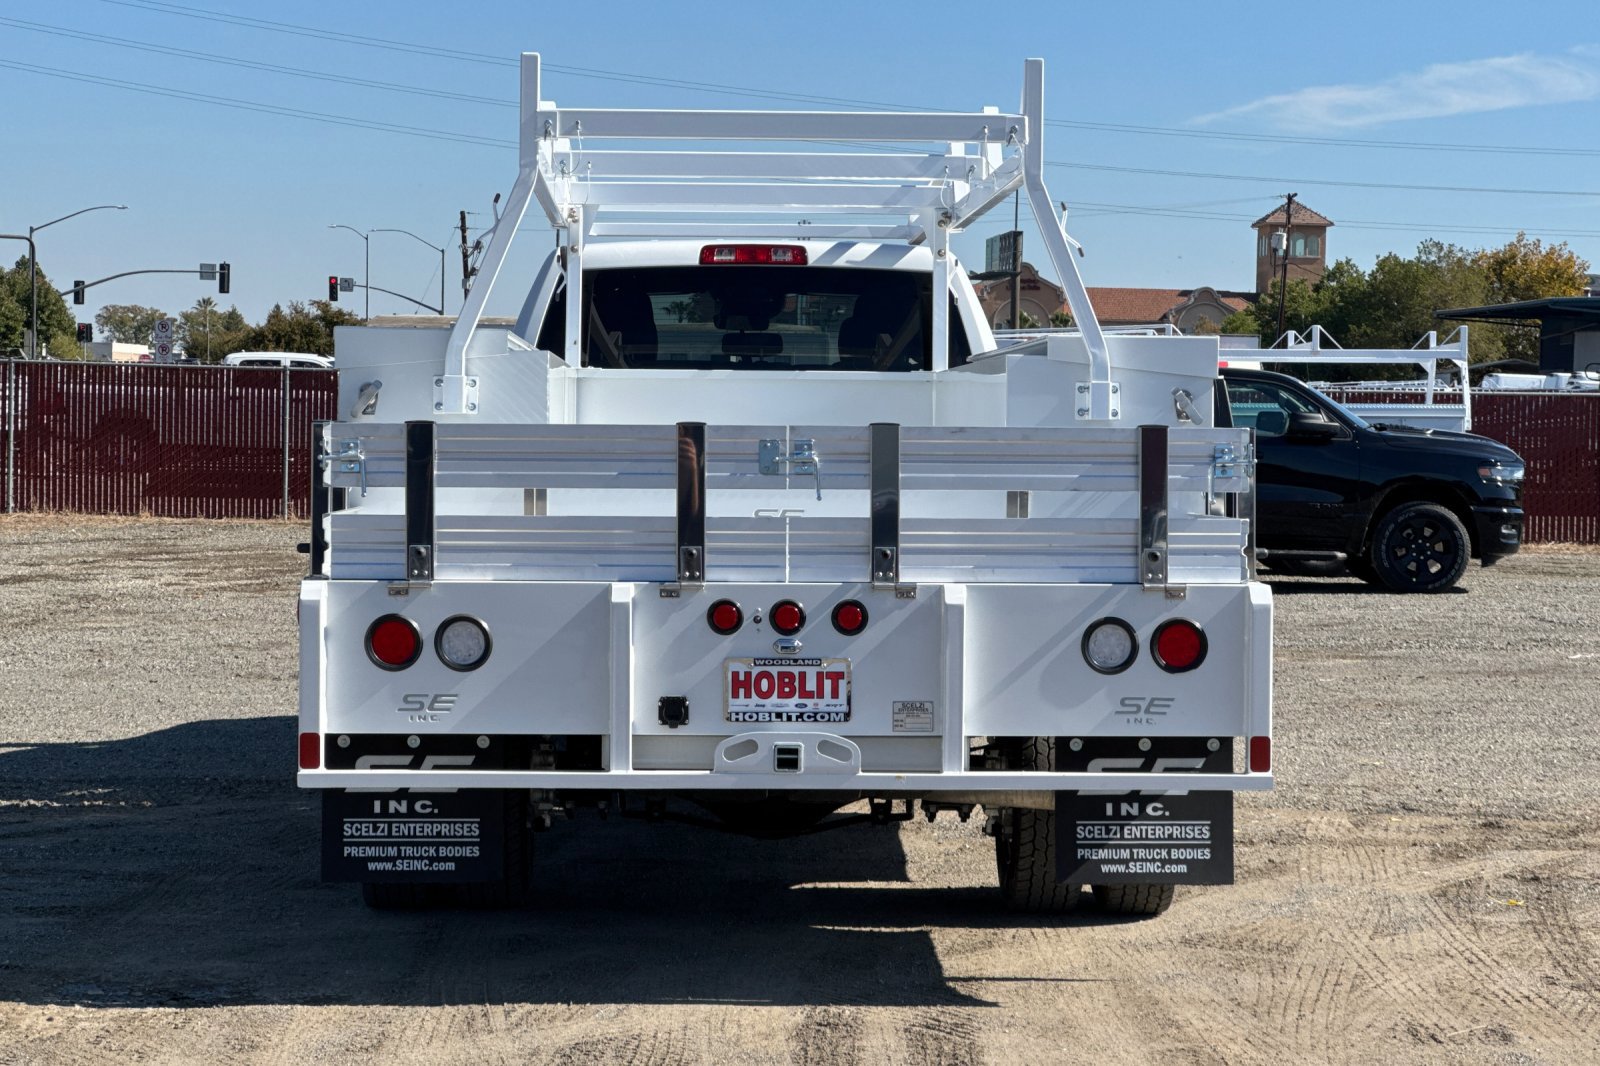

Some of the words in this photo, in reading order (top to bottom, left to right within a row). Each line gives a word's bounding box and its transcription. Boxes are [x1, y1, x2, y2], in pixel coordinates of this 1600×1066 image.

[731, 670, 845, 699] HOBLIT
[397, 693, 459, 711] SE
[1114, 696, 1176, 715] SE
[409, 714, 441, 722] INC.
[731, 712, 845, 722] HOBLIT.COM
[1126, 717, 1157, 726] INC.
[373, 800, 439, 814] INC.
[1105, 802, 1170, 816] INC.
[343, 823, 389, 837] SCELZI
[391, 823, 480, 837] ENTERPRISES
[1076, 825, 1121, 839] SCELZI
[1123, 825, 1211, 839] ENTERPRISES
[343, 846, 398, 857] PREMIUM
[400, 846, 437, 857] TRUCK
[439, 846, 480, 857] BODIES
[1077, 848, 1131, 860] PREMIUM
[1132, 848, 1169, 860] TRUCK
[1171, 848, 1212, 860] BODIES
[367, 860, 456, 871] www.SEINC.com
[1100, 862, 1188, 874] www.SEINC.com
